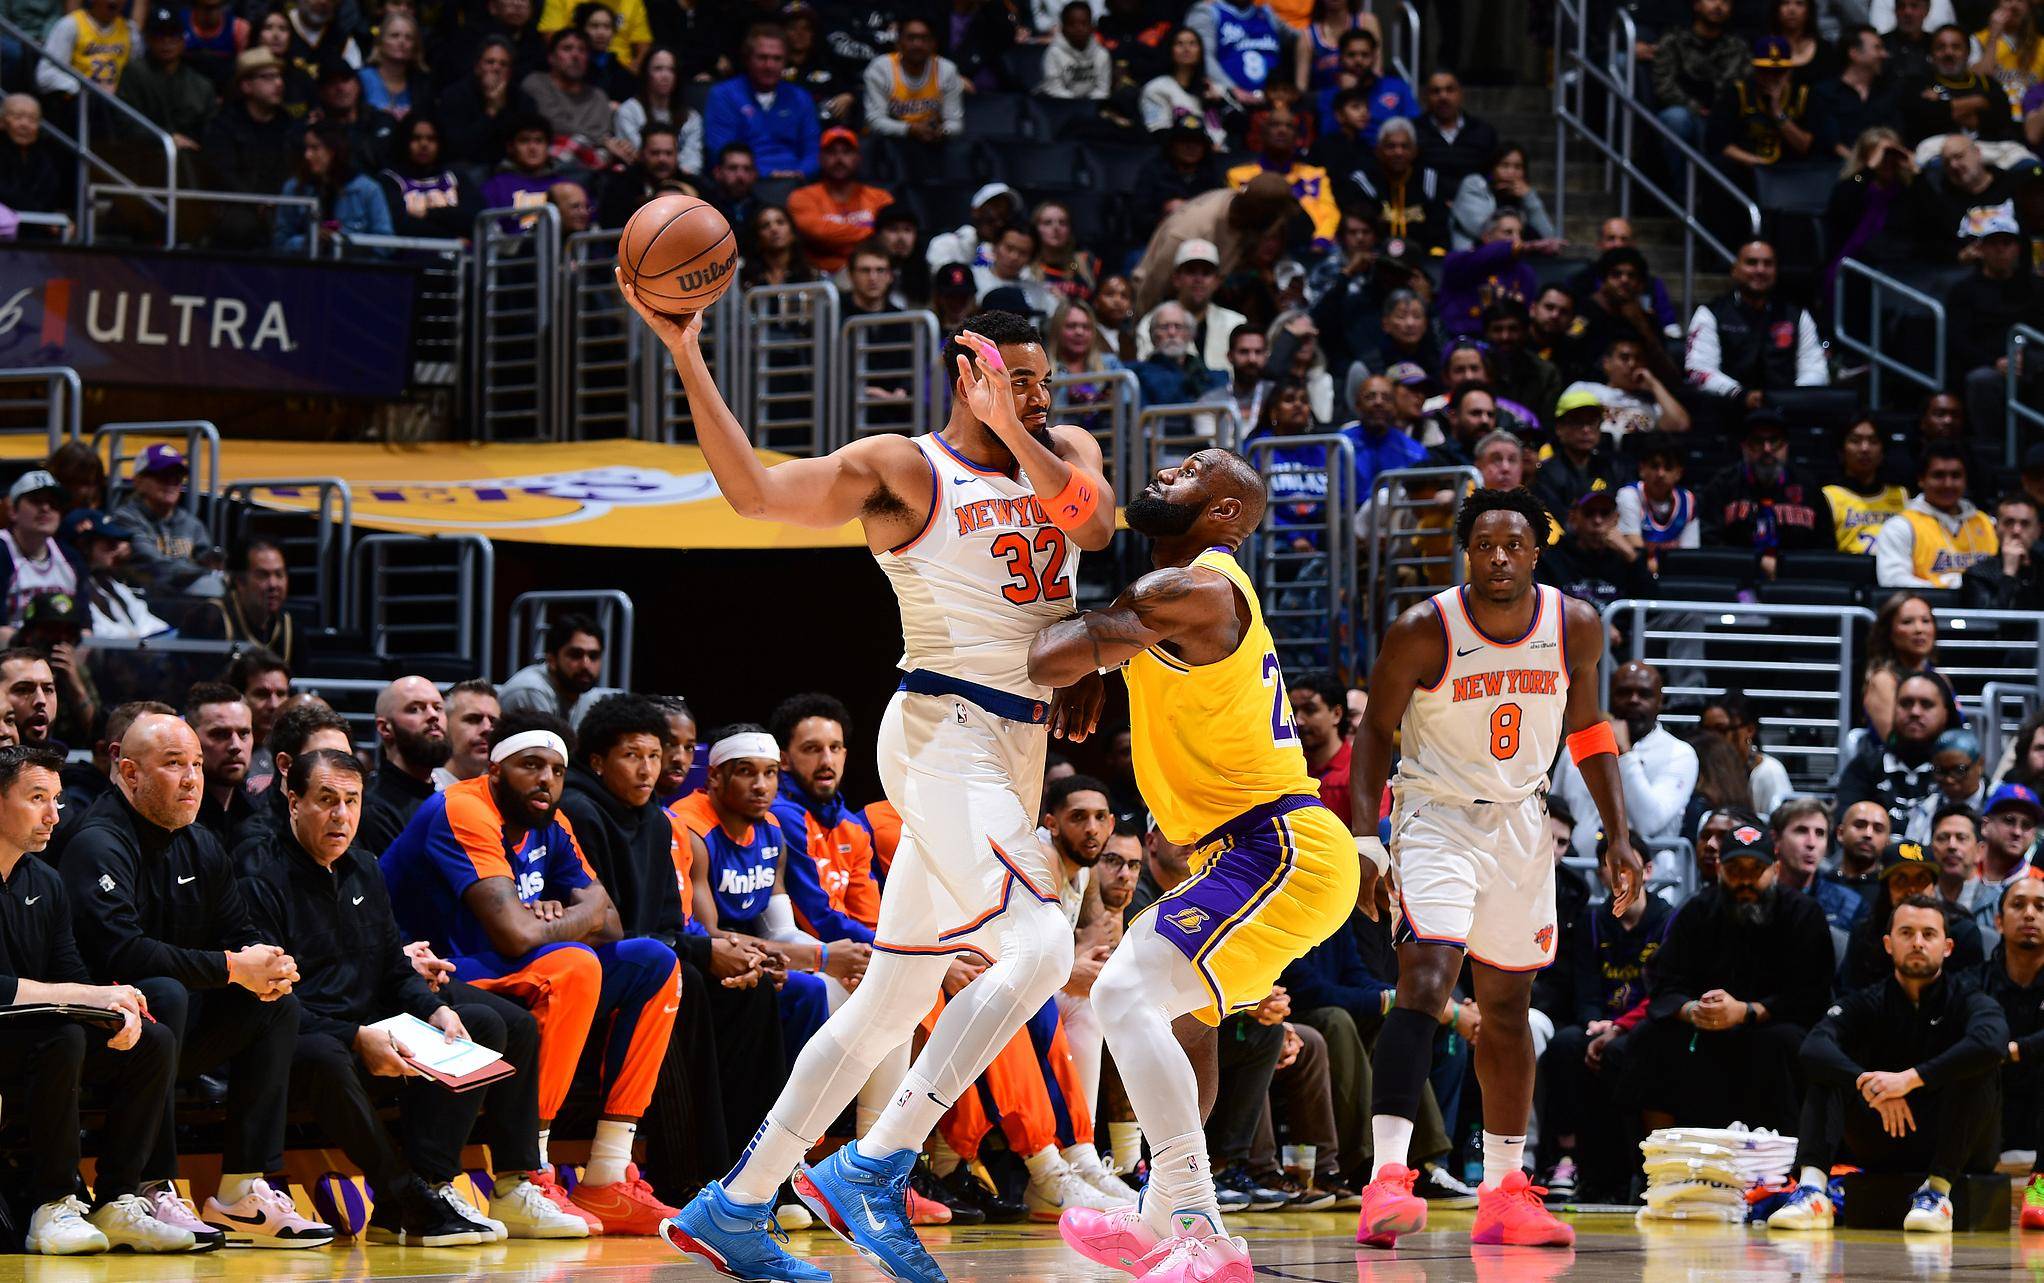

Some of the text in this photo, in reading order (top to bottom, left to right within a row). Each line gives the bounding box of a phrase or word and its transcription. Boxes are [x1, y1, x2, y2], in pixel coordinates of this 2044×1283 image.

[676, 248, 738, 293] Wilson
[86, 289, 292, 352] ULTRA
[955, 494, 1054, 537] NEW YO
[991, 526, 1073, 606] 32
[1262, 650, 1301, 748] 2
[1453, 669, 1559, 703] NEW YORK
[1490, 702, 1522, 761] 8
